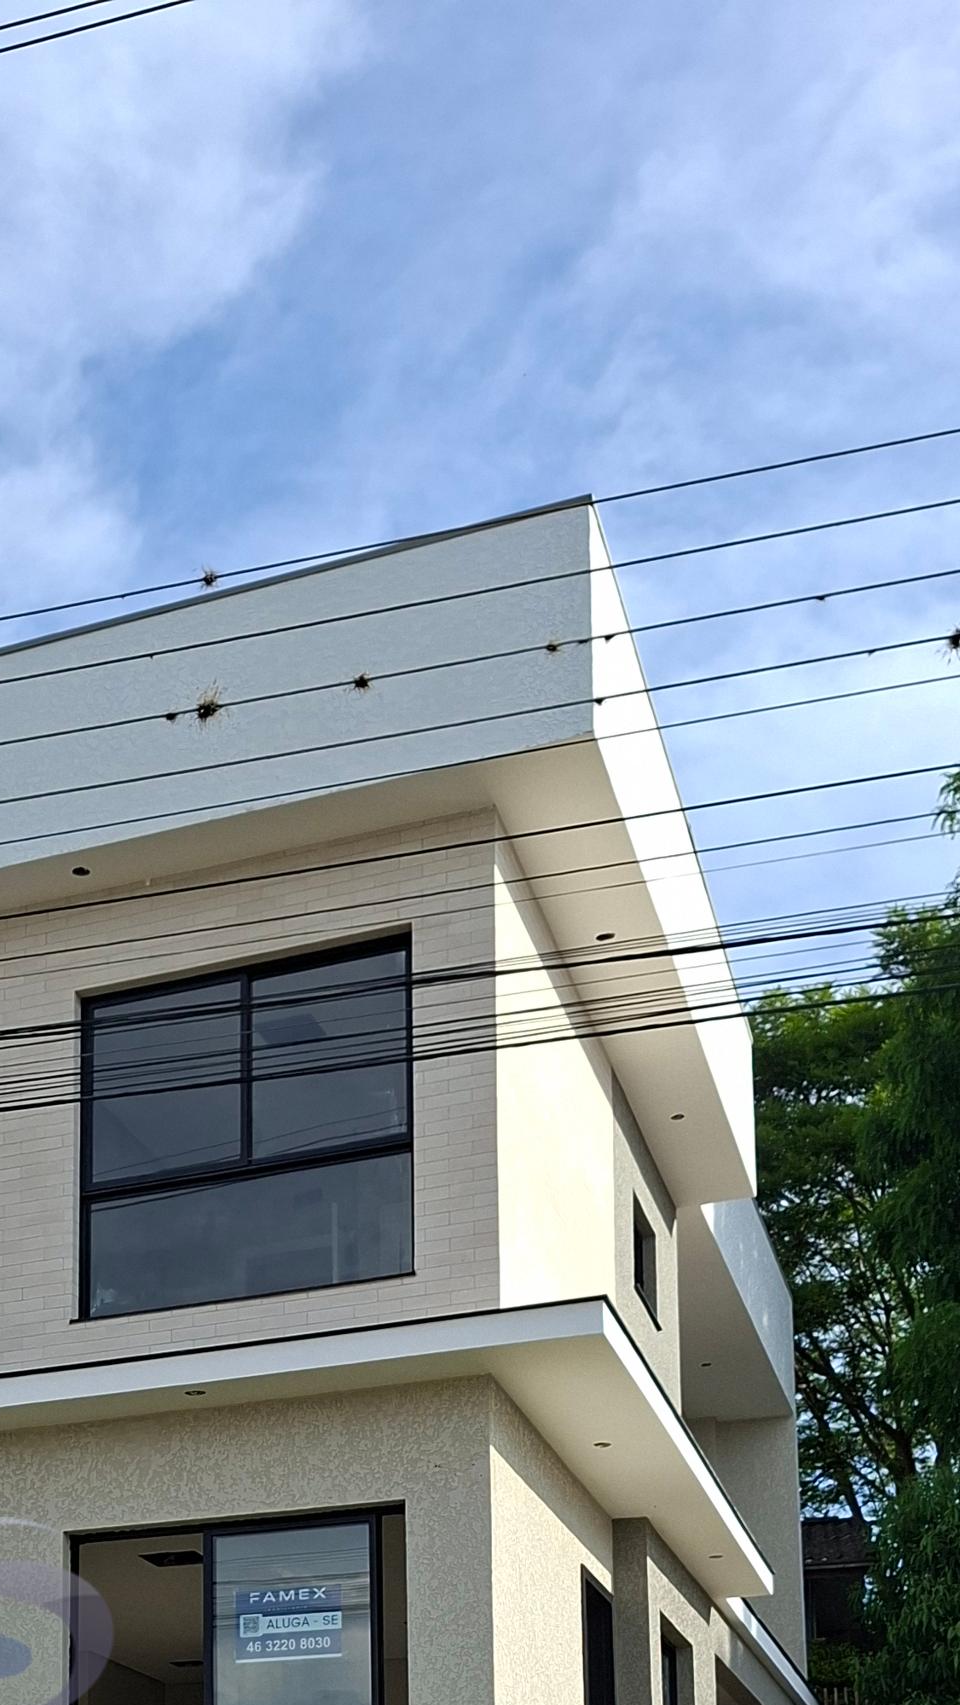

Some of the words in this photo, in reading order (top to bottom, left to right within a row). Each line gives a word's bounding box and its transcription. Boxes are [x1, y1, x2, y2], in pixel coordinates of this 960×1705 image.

[249, 1586, 327, 1604] FAMEX
[266, 1616, 310, 1630] ALUGA
[322, 1614, 339, 1626] SE
[246, 1641, 262, 1653] 46
[265, 1639, 296, 1652] 3220
[300, 1636, 331, 1649] 8030
